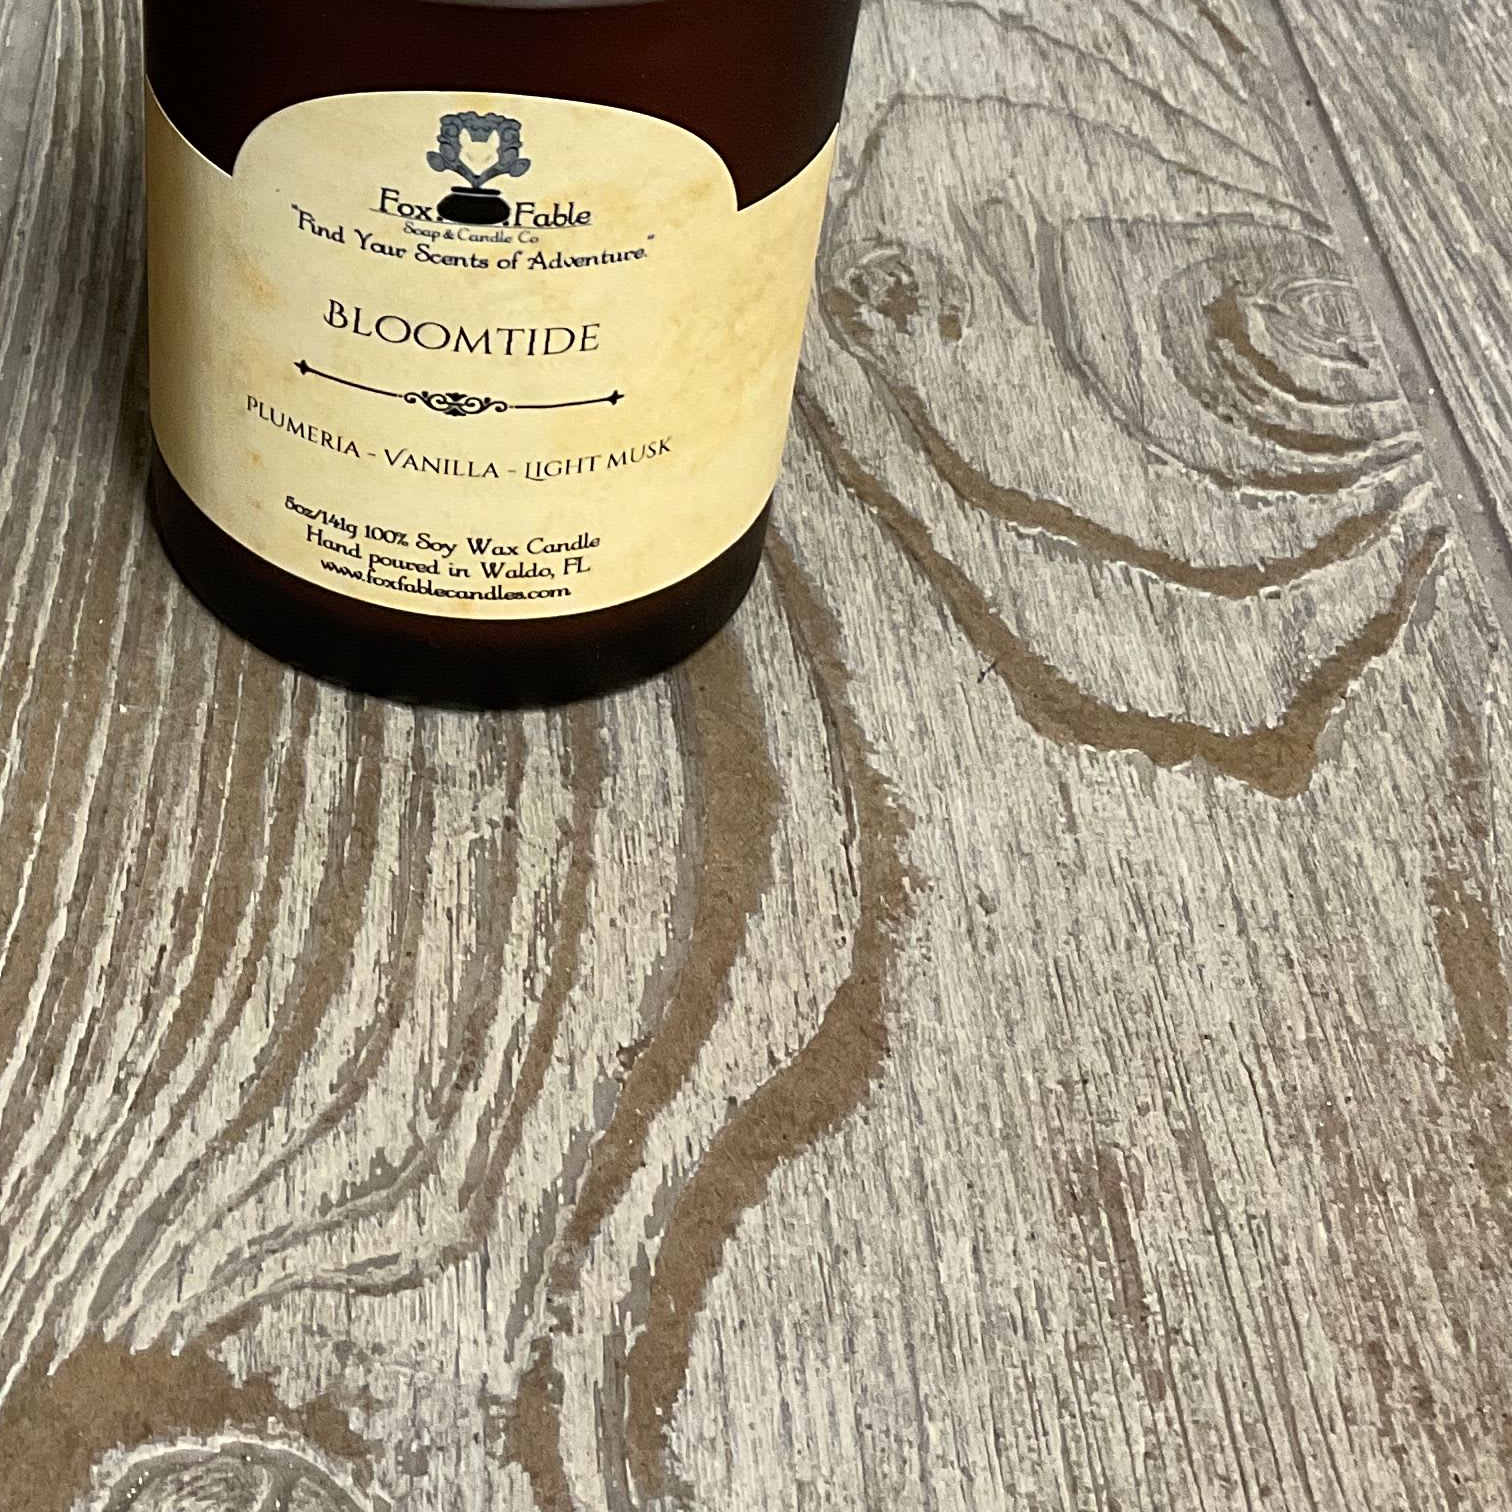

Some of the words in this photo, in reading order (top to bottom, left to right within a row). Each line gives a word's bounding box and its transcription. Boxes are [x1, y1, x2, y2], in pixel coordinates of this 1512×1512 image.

[379, 187, 433, 221] Fox
[514, 202, 591, 228] Fable
[354, 228, 406, 258] Your
[414, 244, 489, 269] Scents
[496, 250, 523, 270] of
[403, 222, 441, 240] Soap
[443, 229, 455, 240] &
[456, 228, 512, 244] Candle
[518, 231, 539, 245] Co
[323, 298, 600, 356] BLOOMTIDE
[246, 395, 360, 458] PLUMERIA
[384, 447, 500, 479] VANILLA
[606, 436, 672, 470] MUSK
[284, 496, 358, 538] 5oz/141g
[365, 525, 409, 547] 100%
[415, 532, 457, 558] Soy
[466, 537, 519, 555] Wax
[526, 532, 601, 554] Candle
[305, 524, 363, 560] Hand
[368, 552, 441, 577] poured
[448, 562, 469, 577] in
[480, 561, 555, 581] Waldo,
[320, 558, 571, 601] www.foxfablecandles.com
